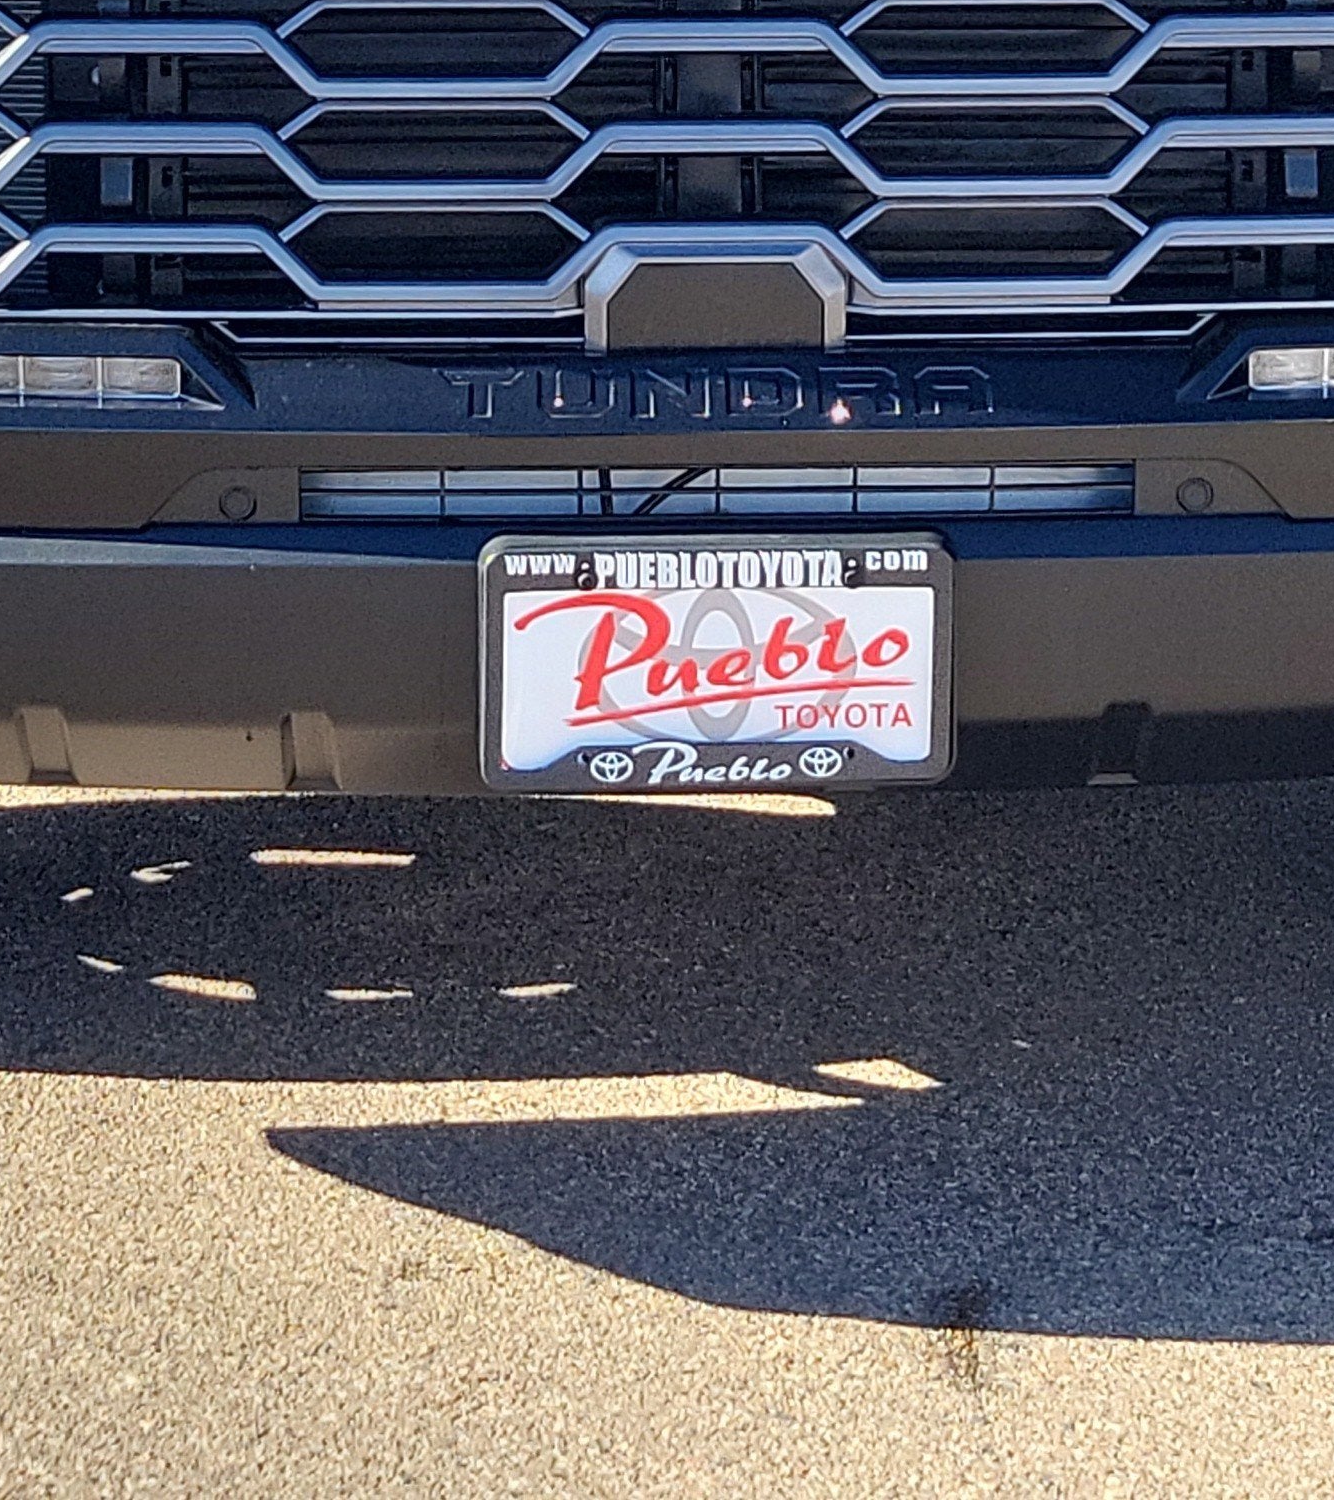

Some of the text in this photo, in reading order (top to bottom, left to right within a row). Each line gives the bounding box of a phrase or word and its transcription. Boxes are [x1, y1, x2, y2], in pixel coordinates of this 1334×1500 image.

[433, 365, 995, 419] TUNDRA
[514, 591, 910, 711] Pueblo
[774, 703, 914, 731] TOYOTA
[632, 741, 793, 784] Pueblo
